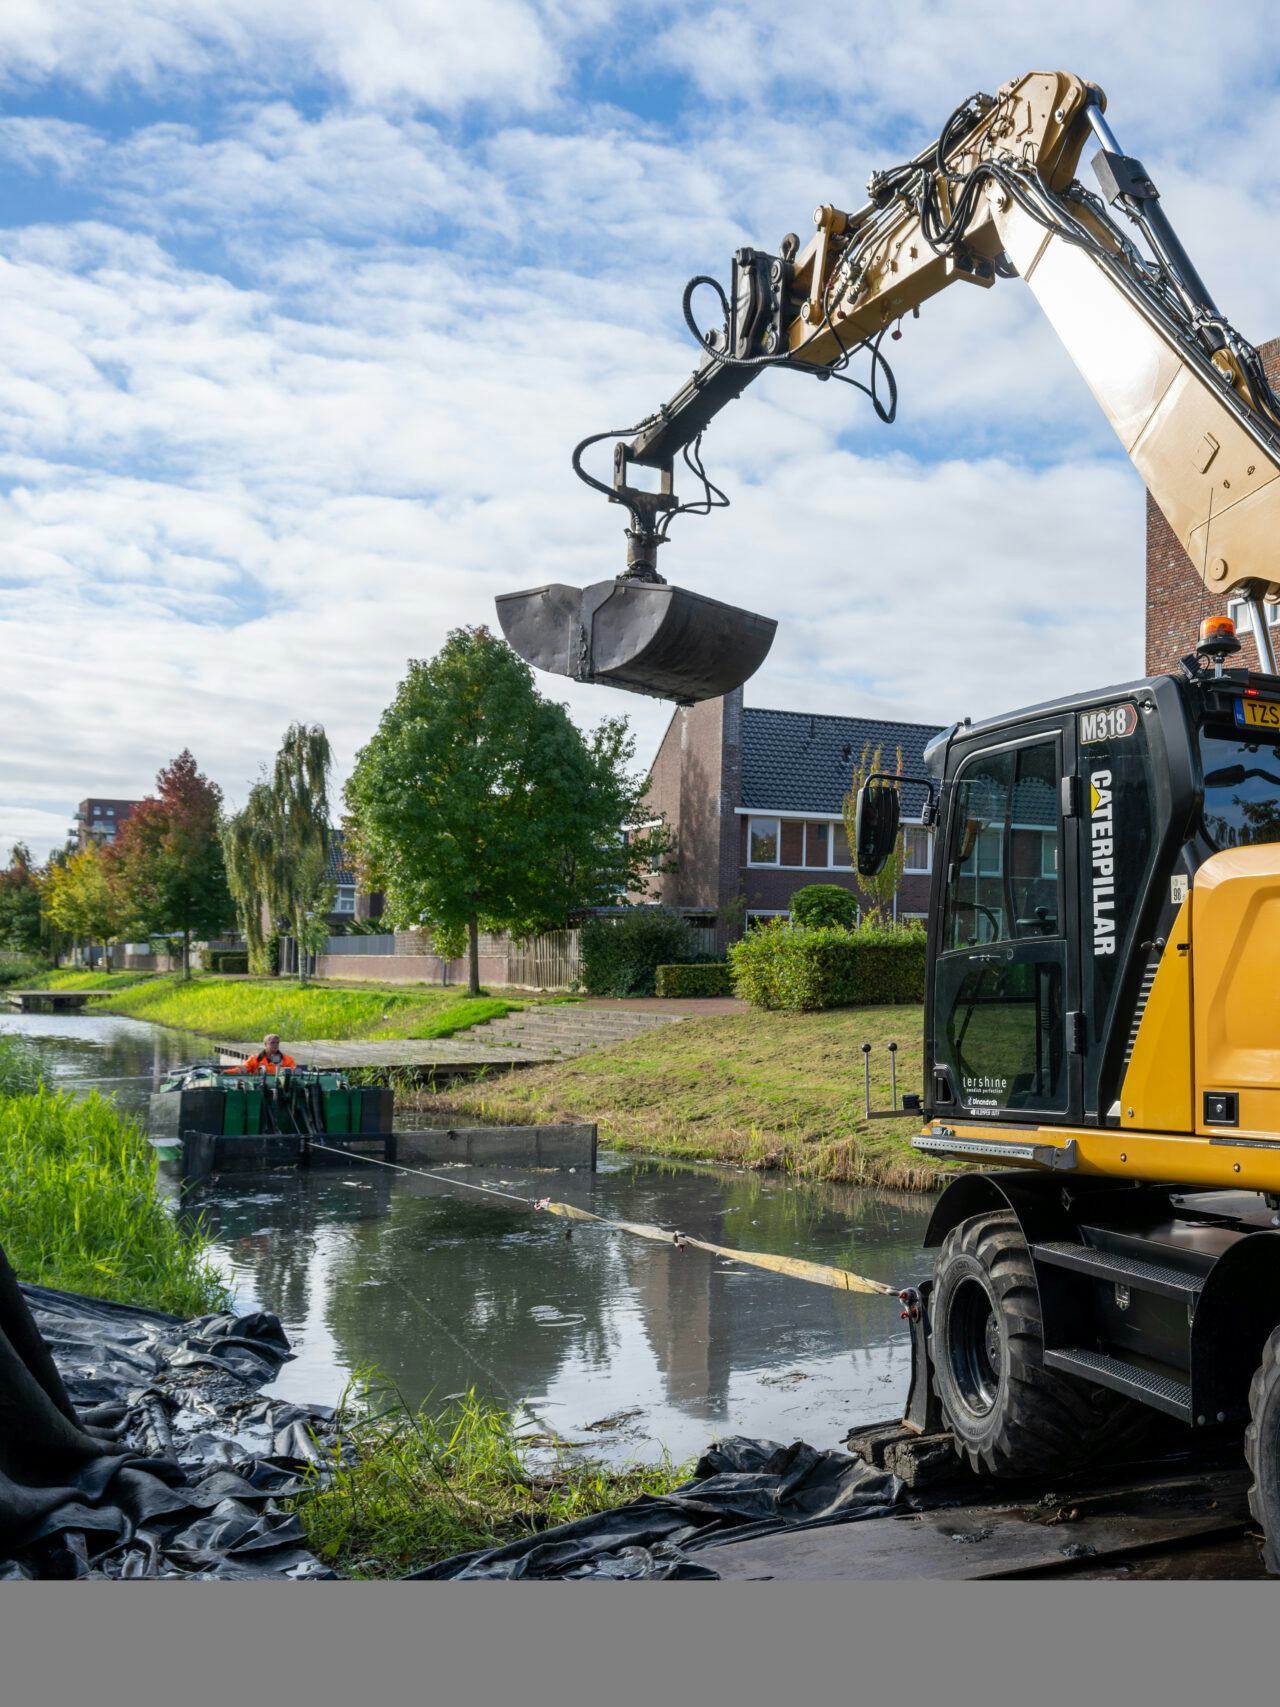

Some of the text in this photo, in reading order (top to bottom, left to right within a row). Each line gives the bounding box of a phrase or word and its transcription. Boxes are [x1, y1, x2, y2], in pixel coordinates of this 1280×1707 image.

[1081, 707, 1128, 742] M318
[1091, 769, 1116, 956] CATERPILLAR
[1173, 887, 1182, 901] 98
